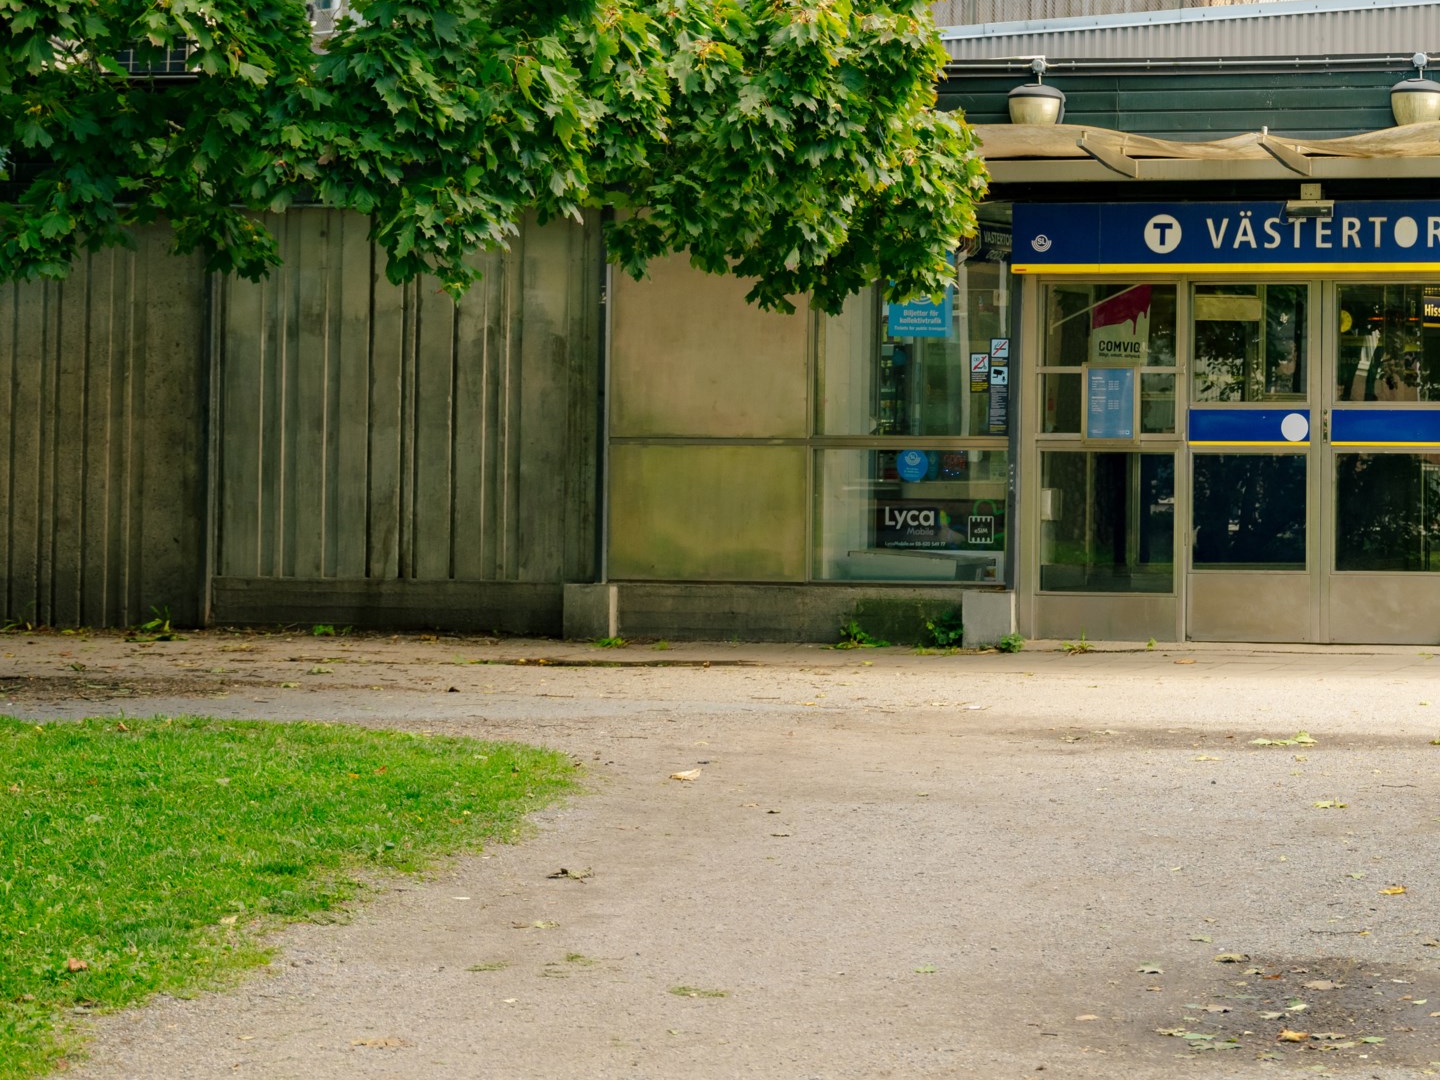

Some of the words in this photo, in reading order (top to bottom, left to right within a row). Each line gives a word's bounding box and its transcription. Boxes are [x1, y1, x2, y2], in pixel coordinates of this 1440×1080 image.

[1098, 340, 1141, 353] COMVIQ
[885, 506, 935, 529] Lyca
[906, 527, 934, 536] Mobile
